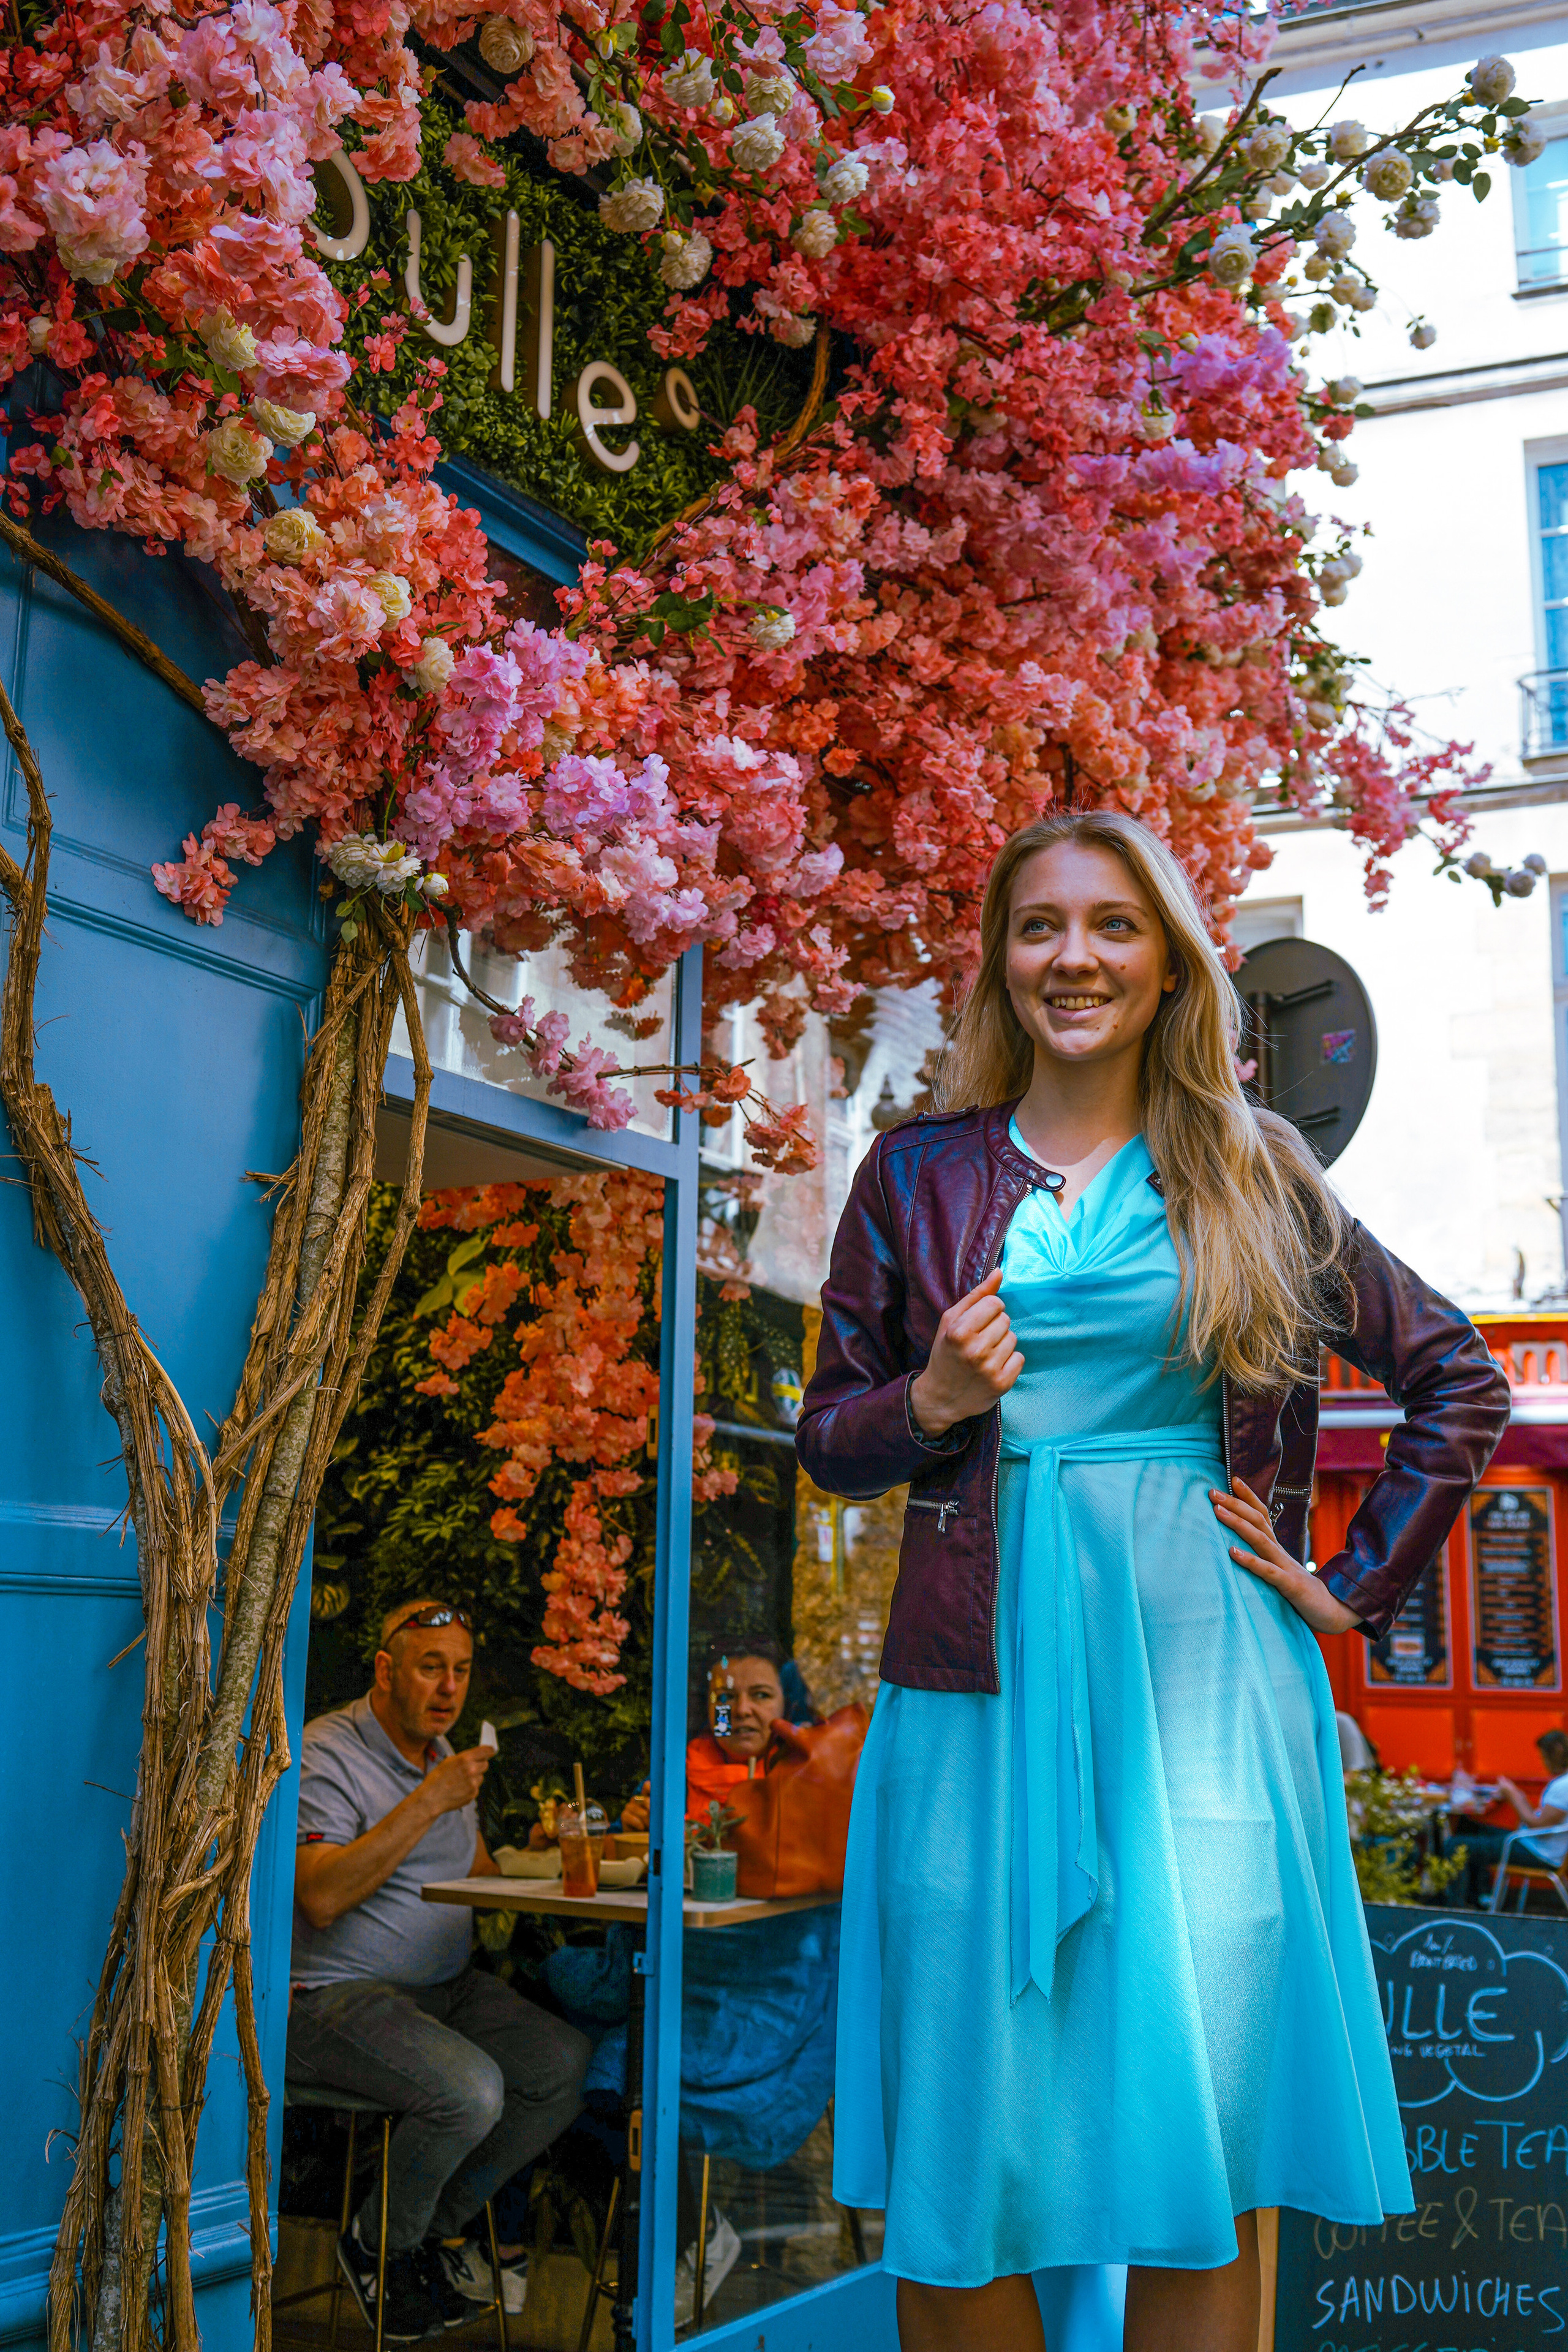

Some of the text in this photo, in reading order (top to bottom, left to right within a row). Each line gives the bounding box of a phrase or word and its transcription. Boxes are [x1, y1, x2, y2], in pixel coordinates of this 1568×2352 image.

[1474, 2119, 1568, 2176] TEA
[1450, 2186, 1479, 2250] &
[1488, 2198, 1568, 2250] TEA
